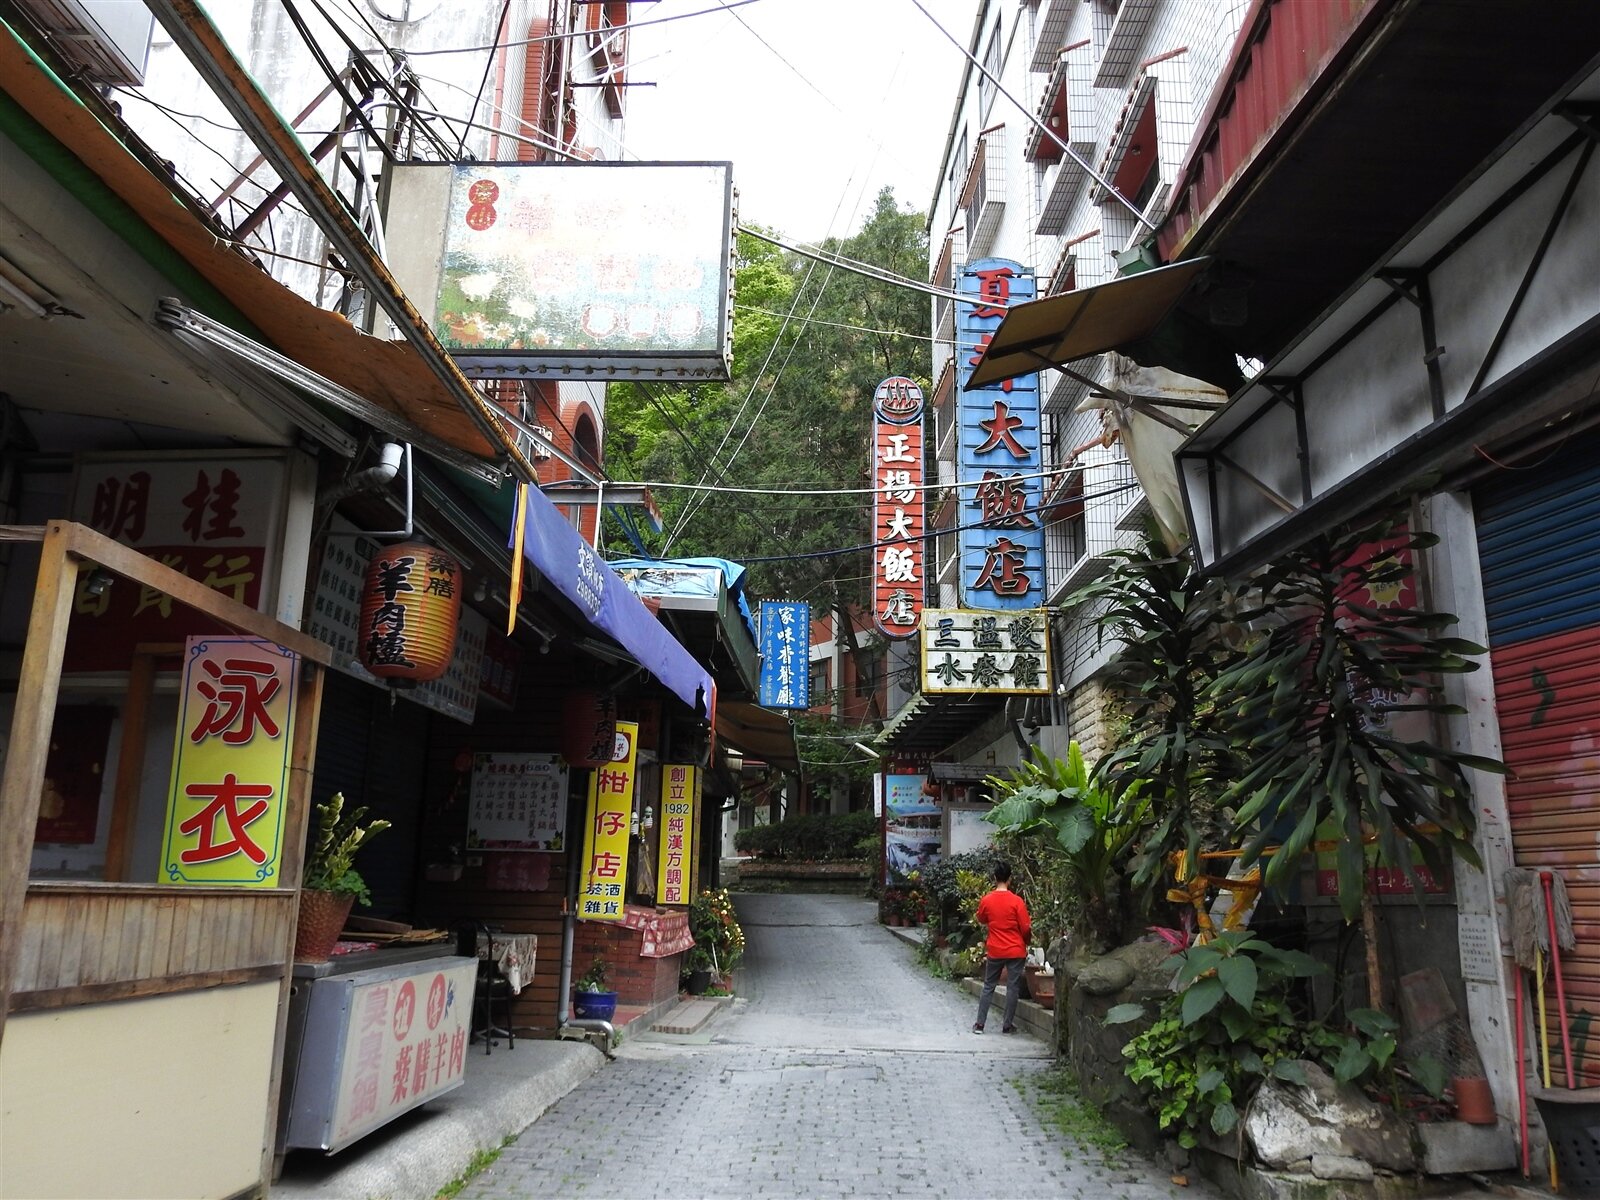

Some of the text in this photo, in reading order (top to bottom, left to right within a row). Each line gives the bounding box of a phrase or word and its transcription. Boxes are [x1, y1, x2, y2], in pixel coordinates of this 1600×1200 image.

[969, 267, 1033, 595] 夏大飯店
[91, 468, 245, 543] 明桂
[881, 434, 919, 625] 正揚大飯店
[423, 551, 456, 599] 藥膳
[934, 616, 1041, 649] 三溫暖
[934, 652, 1041, 687] 水療館
[180, 659, 281, 865] 泳衣
[592, 770, 629, 877] 柑仔店
[584, 900, 619, 914] 雜貨
